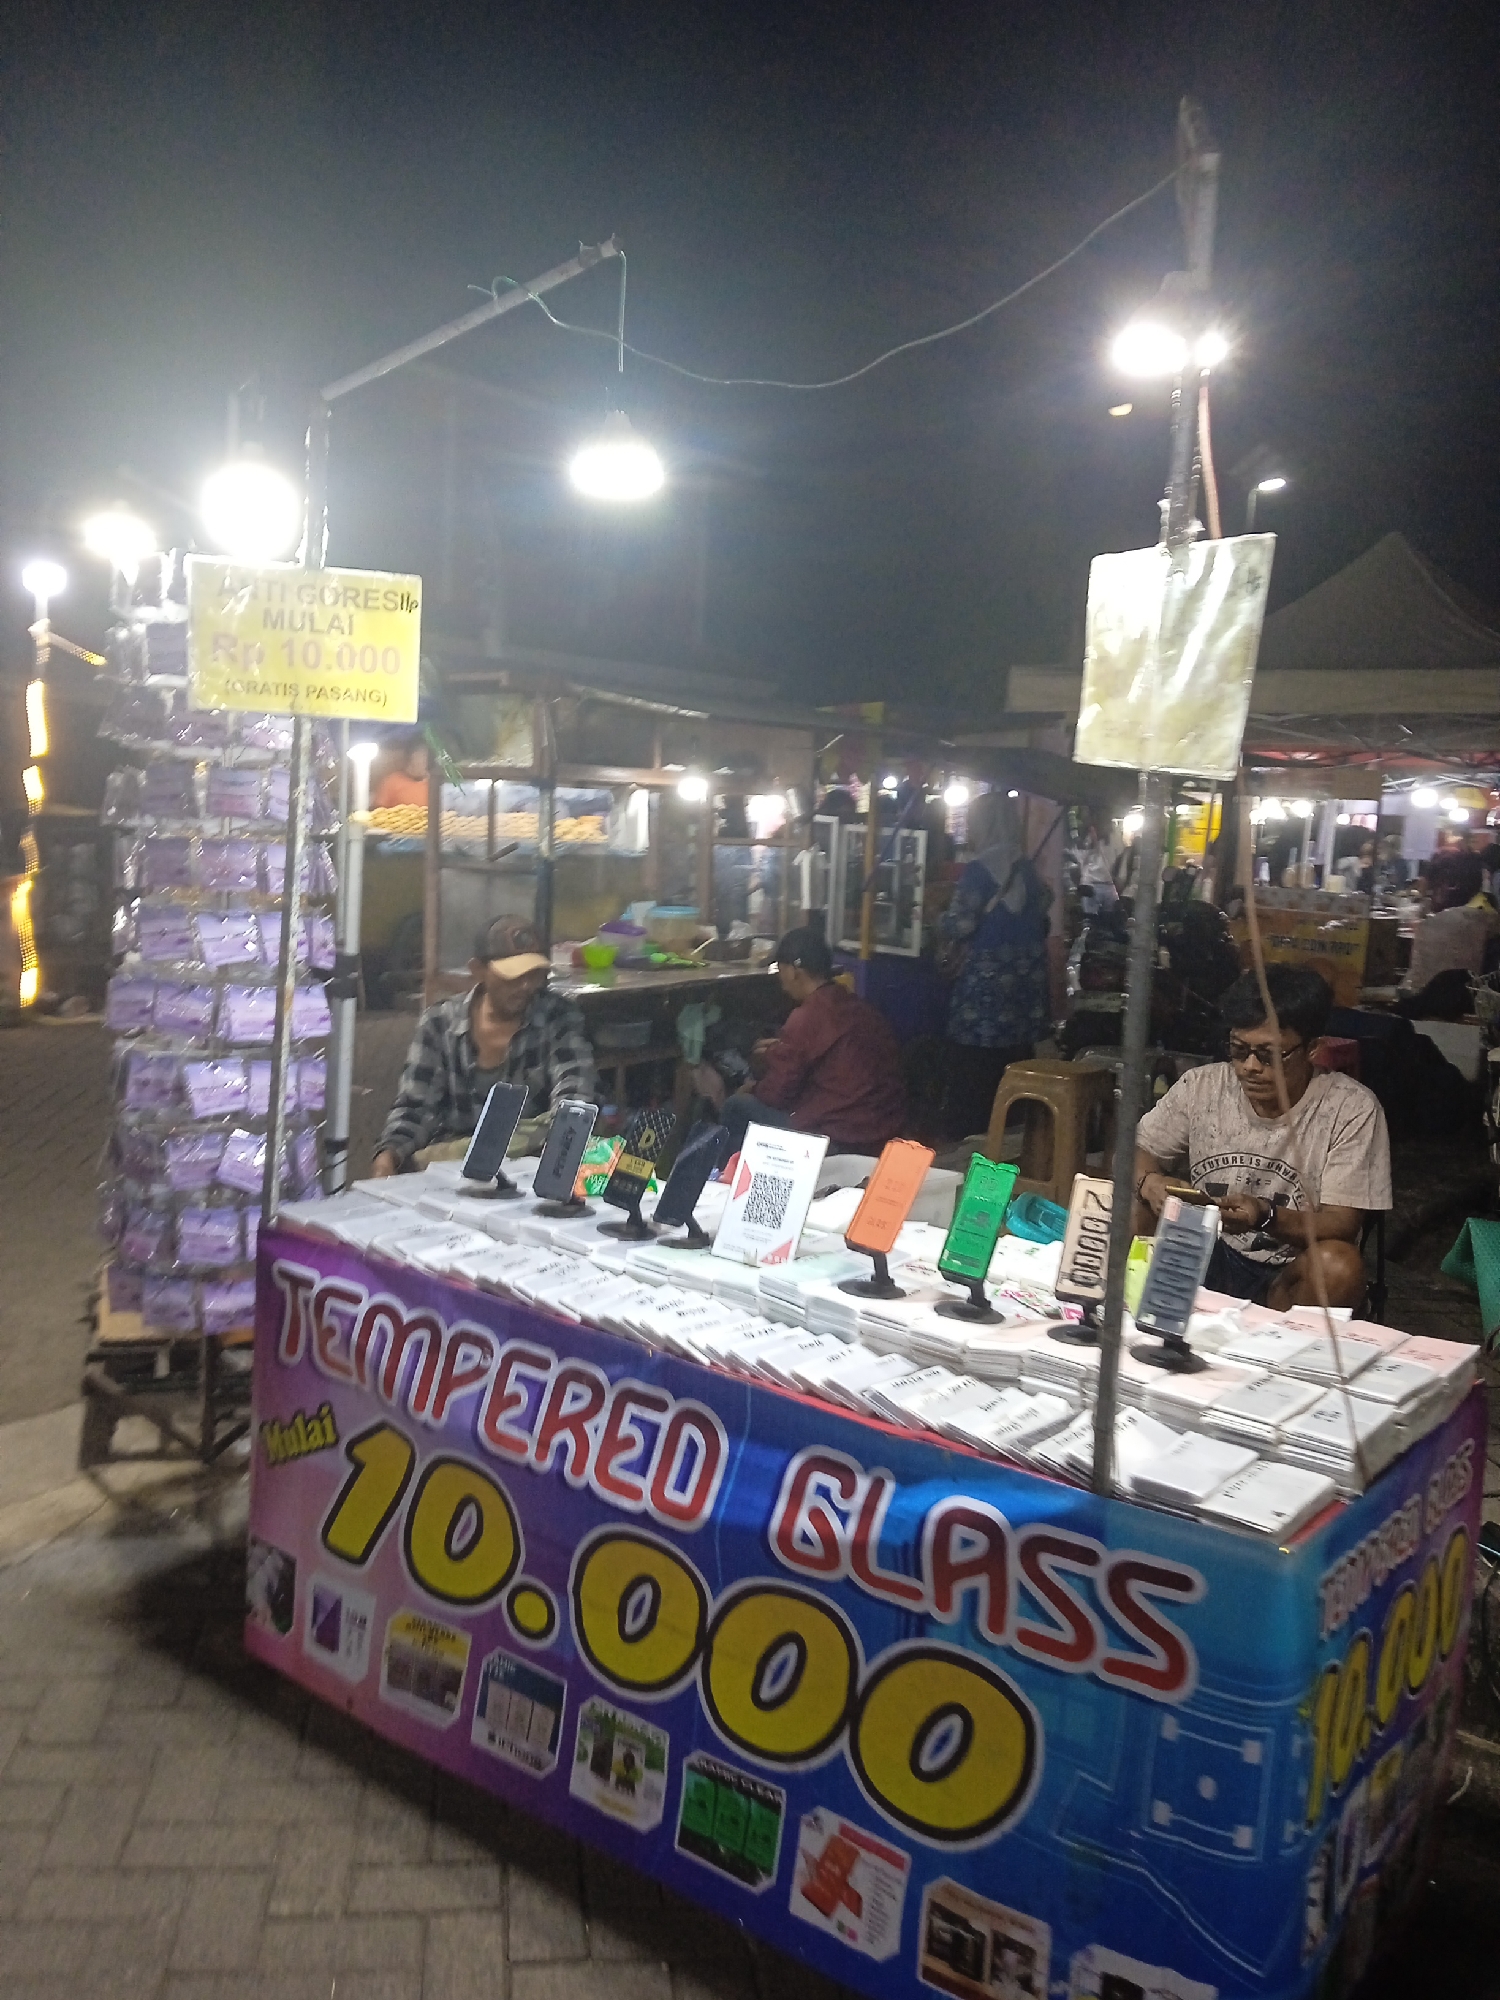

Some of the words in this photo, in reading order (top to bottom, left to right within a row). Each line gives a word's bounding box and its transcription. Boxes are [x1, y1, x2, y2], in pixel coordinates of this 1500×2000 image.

[297, 583, 399, 612] GORES
[262, 607, 354, 636] MULAI
[211, 631, 264, 673] Rp
[281, 637, 400, 675] 10.000
[224, 679, 299, 699] (GRATIS
[306, 685, 388, 707] PASANG)
[1203, 1155, 1245, 1172] FUTURE
[1249, 1156, 1262, 1168] IS
[273, 1260, 727, 1532] TEMPERED
[769, 1445, 1207, 1701] GLASS
[321, 1418, 1042, 1850] 10.000
